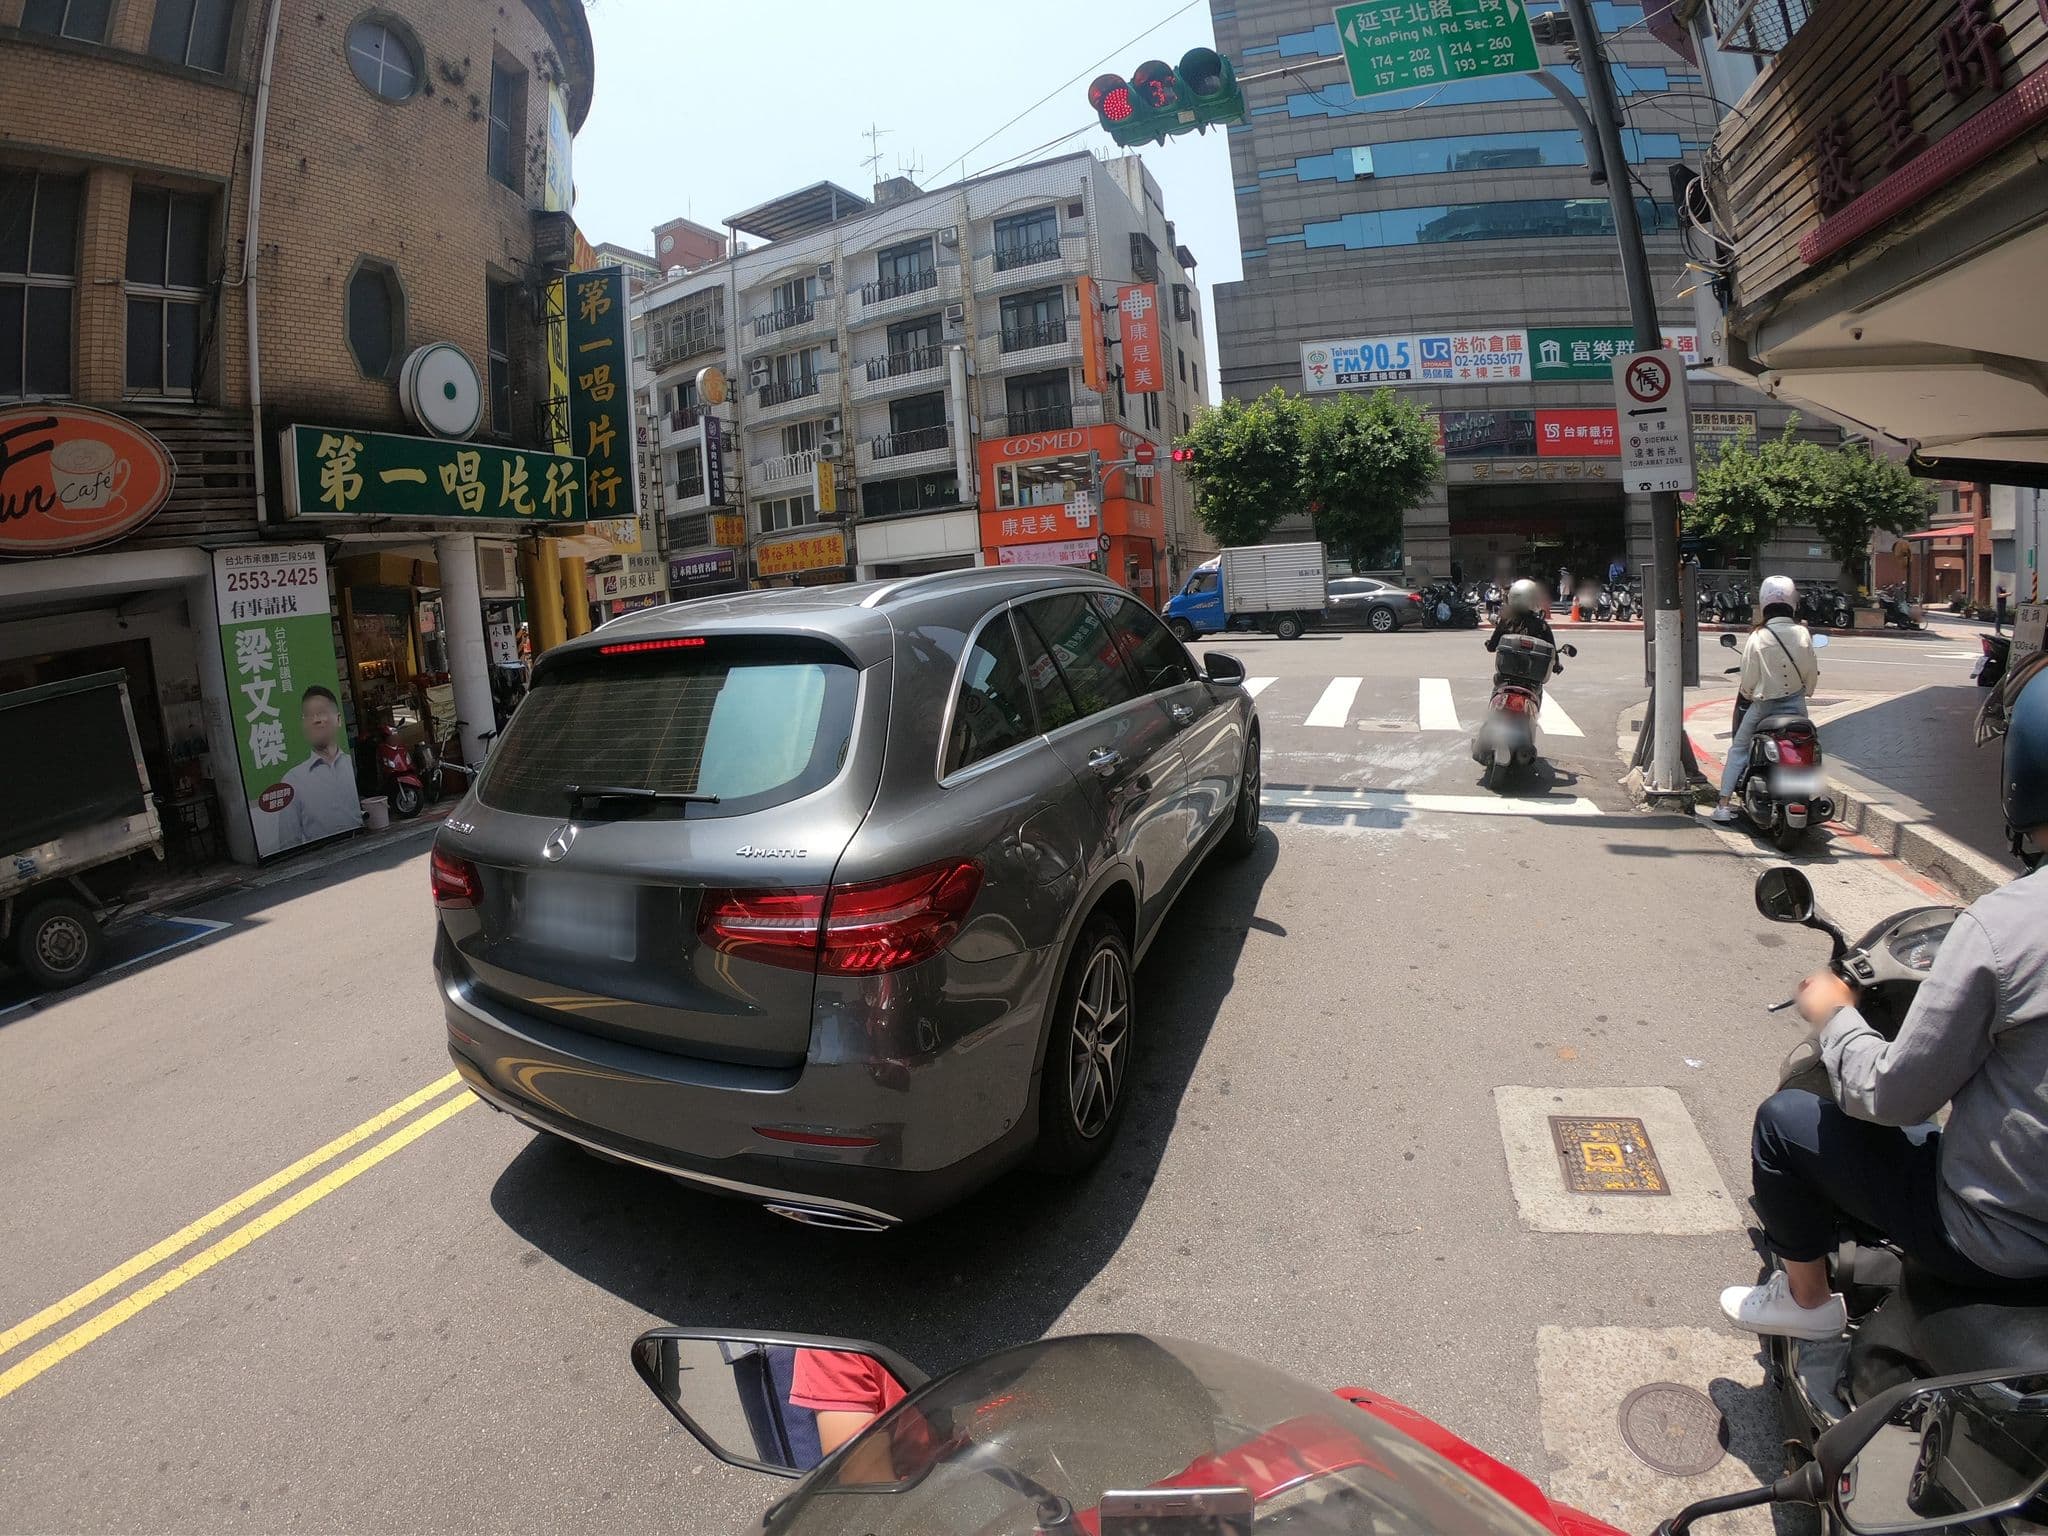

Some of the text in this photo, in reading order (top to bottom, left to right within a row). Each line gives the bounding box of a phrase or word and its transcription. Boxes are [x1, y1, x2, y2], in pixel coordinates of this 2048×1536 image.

[1363, 15, 1506, 48] YanPing N. Rd. Sec. 2
[1449, 42, 1473, 56] 214
[1488, 36, 1512, 50] 260
[1370, 54, 1393, 69] 174
[1409, 48, 1432, 62] 202
[1454, 58, 1477, 72] 193
[1493, 53, 1515, 67] 237
[1374, 71, 1395, 86] 157
[1413, 65, 1435, 79] 185
[1331, 346, 1359, 357] Taiwan
[1422, 341, 1449, 360] UR
[1452, 334, 1523, 354] 迷你倉庫
[1570, 339, 1636, 361] 富樂群
[1128, 322, 1153, 387] 康是美
[1333, 341, 1410, 374] FM 90.5
[1454, 352, 1523, 367] 02-26536177
[1459, 365, 1521, 380] 本棟三樓
[577, 277, 623, 509] 第一唱片行
[1564, 425, 1614, 438] 台新銀行
[1644, 434, 1679, 444] SIDEWALK
[1003, 431, 1083, 457] COSMED
[1629, 456, 1684, 468] TOW-AWAY ZONE
[315, 433, 580, 519] 第一唱片行
[1659, 480, 1679, 490] 110
[1001, 513, 1057, 536] 康是美
[225, 551, 316, 566] 台北市承德路三段54號
[227, 567, 318, 592] 2553-2425
[619, 573, 657, 590] 阿瘦皮鞋
[231, 595, 298, 619] 有事請找
[274, 626, 294, 693] 台北市議員
[234, 627, 289, 770] 梁文傑
[735, 844, 808, 860] 4MATIC
